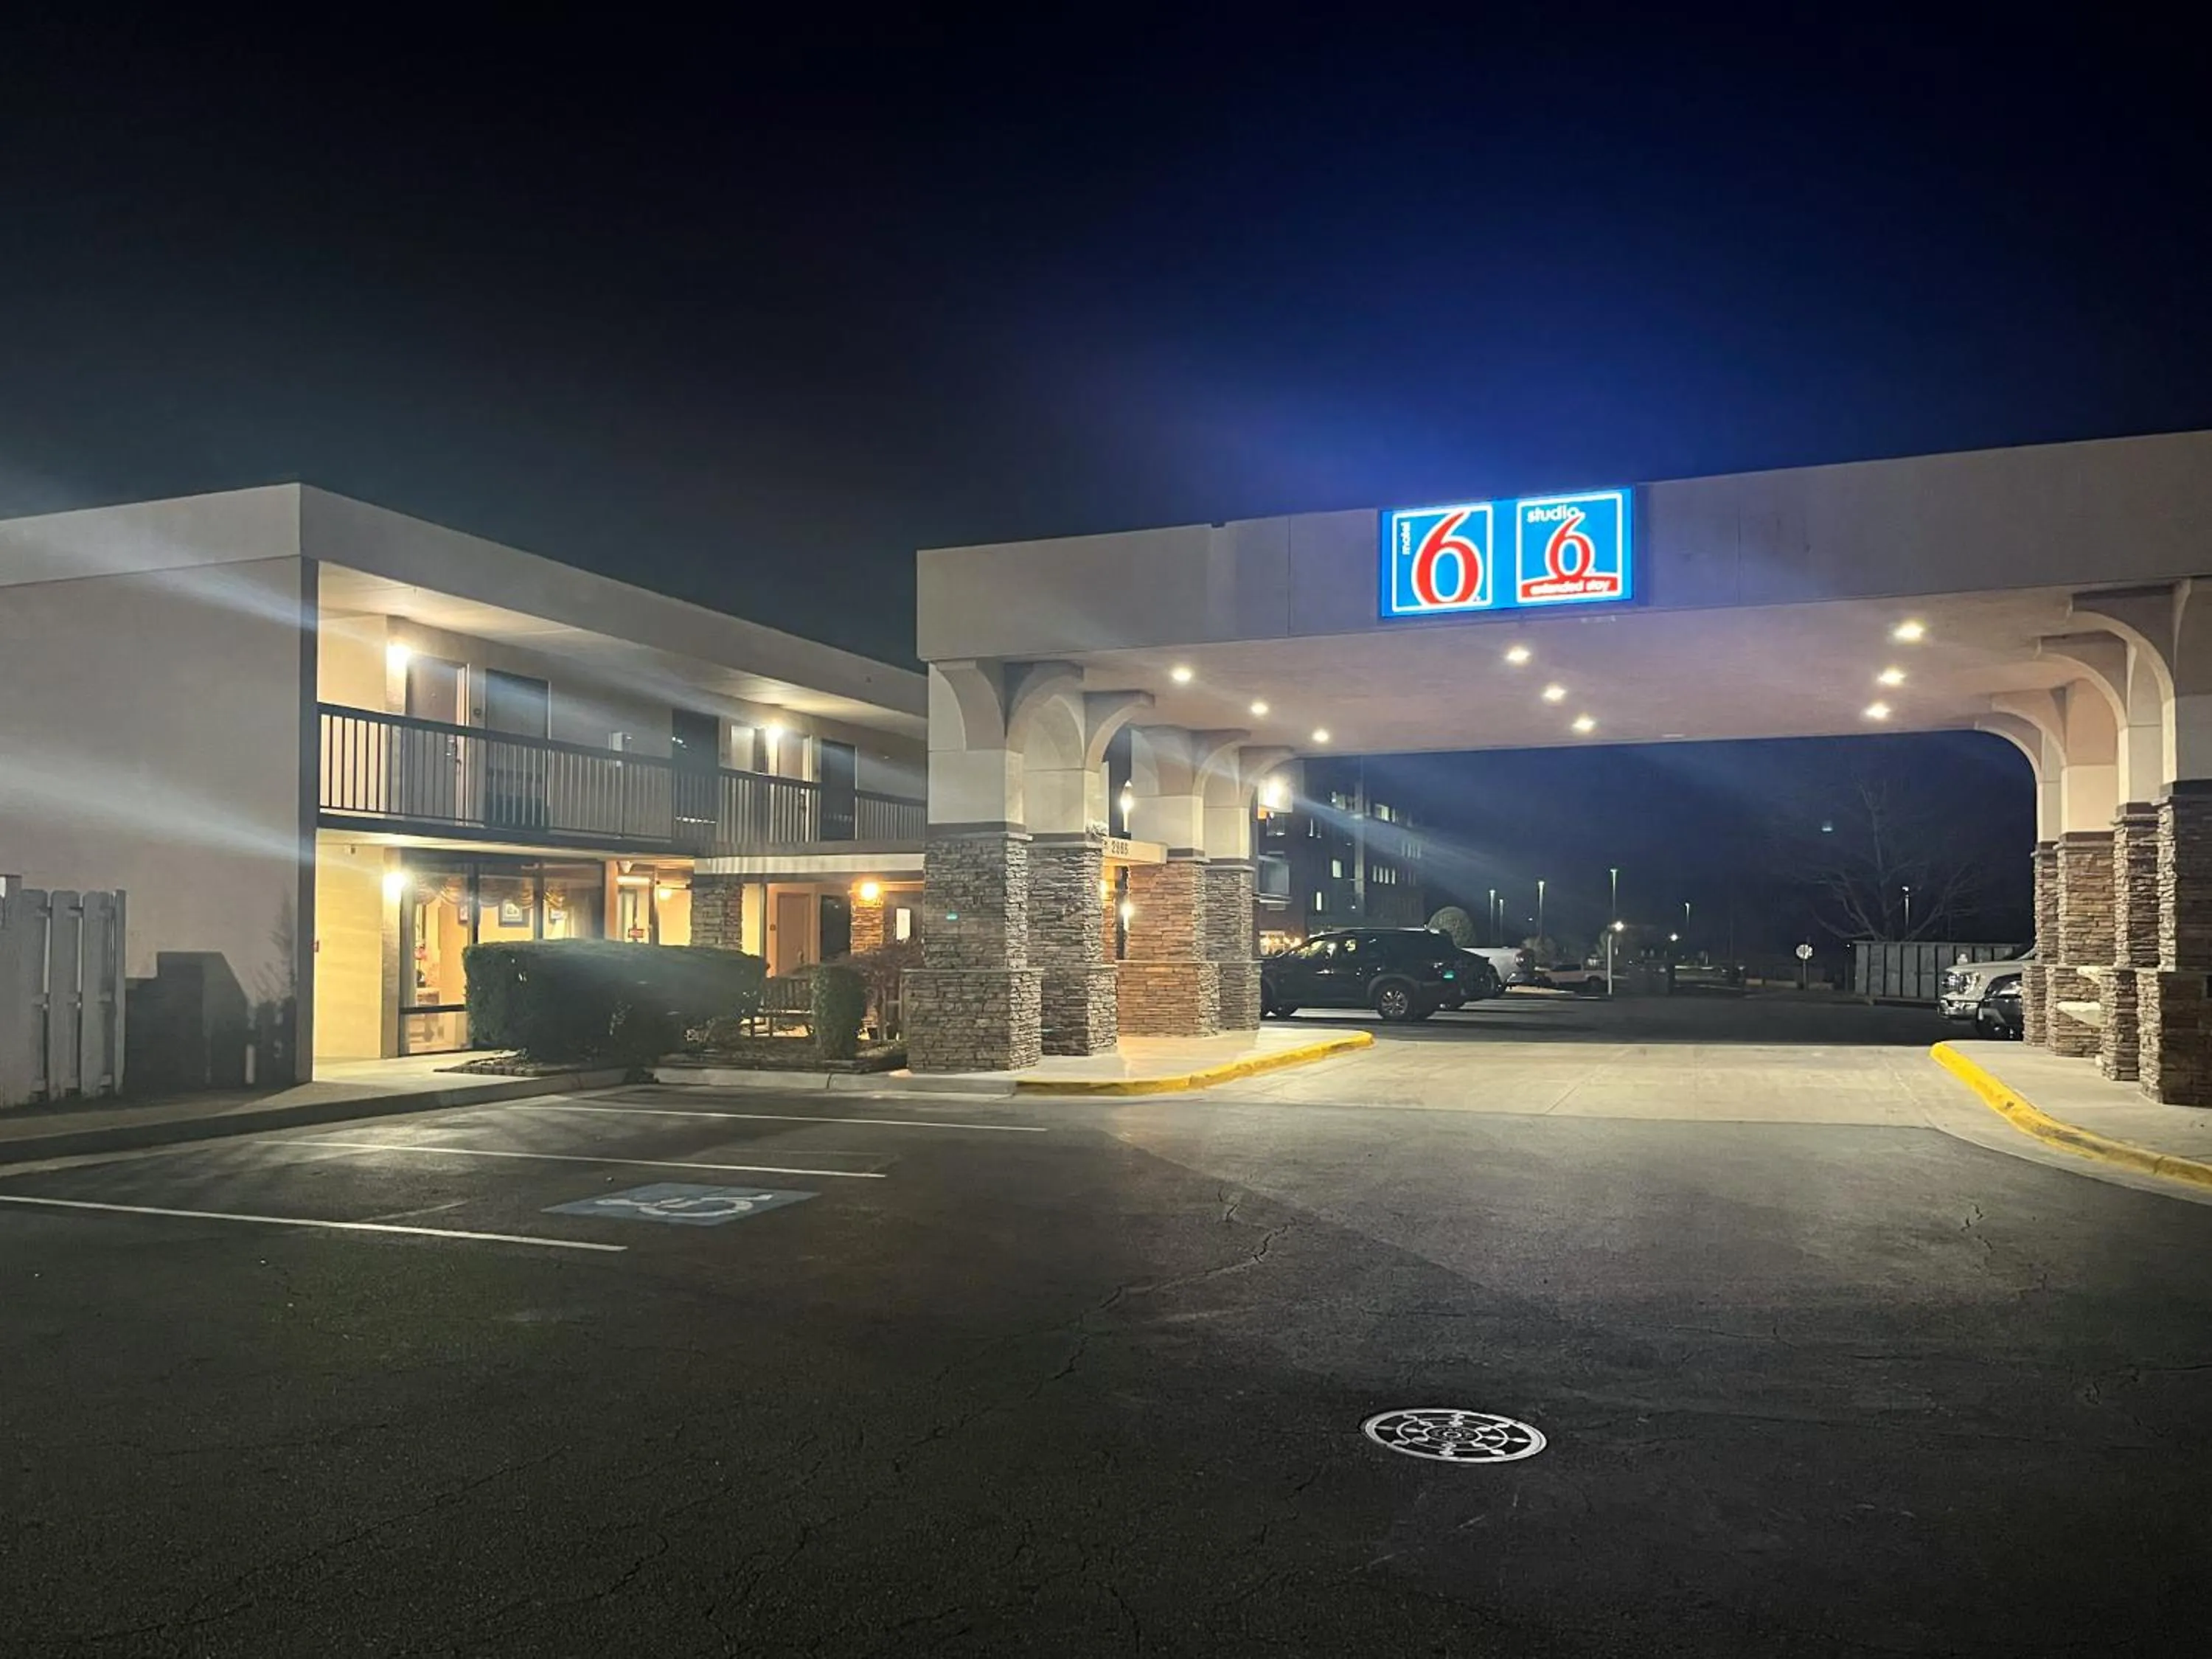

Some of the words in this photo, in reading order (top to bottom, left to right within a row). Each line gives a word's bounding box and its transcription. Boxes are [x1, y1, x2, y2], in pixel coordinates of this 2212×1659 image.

[1527, 504, 1580, 523] studio
[1545, 511, 1595, 582] 6
[1411, 505, 1483, 605] 6
